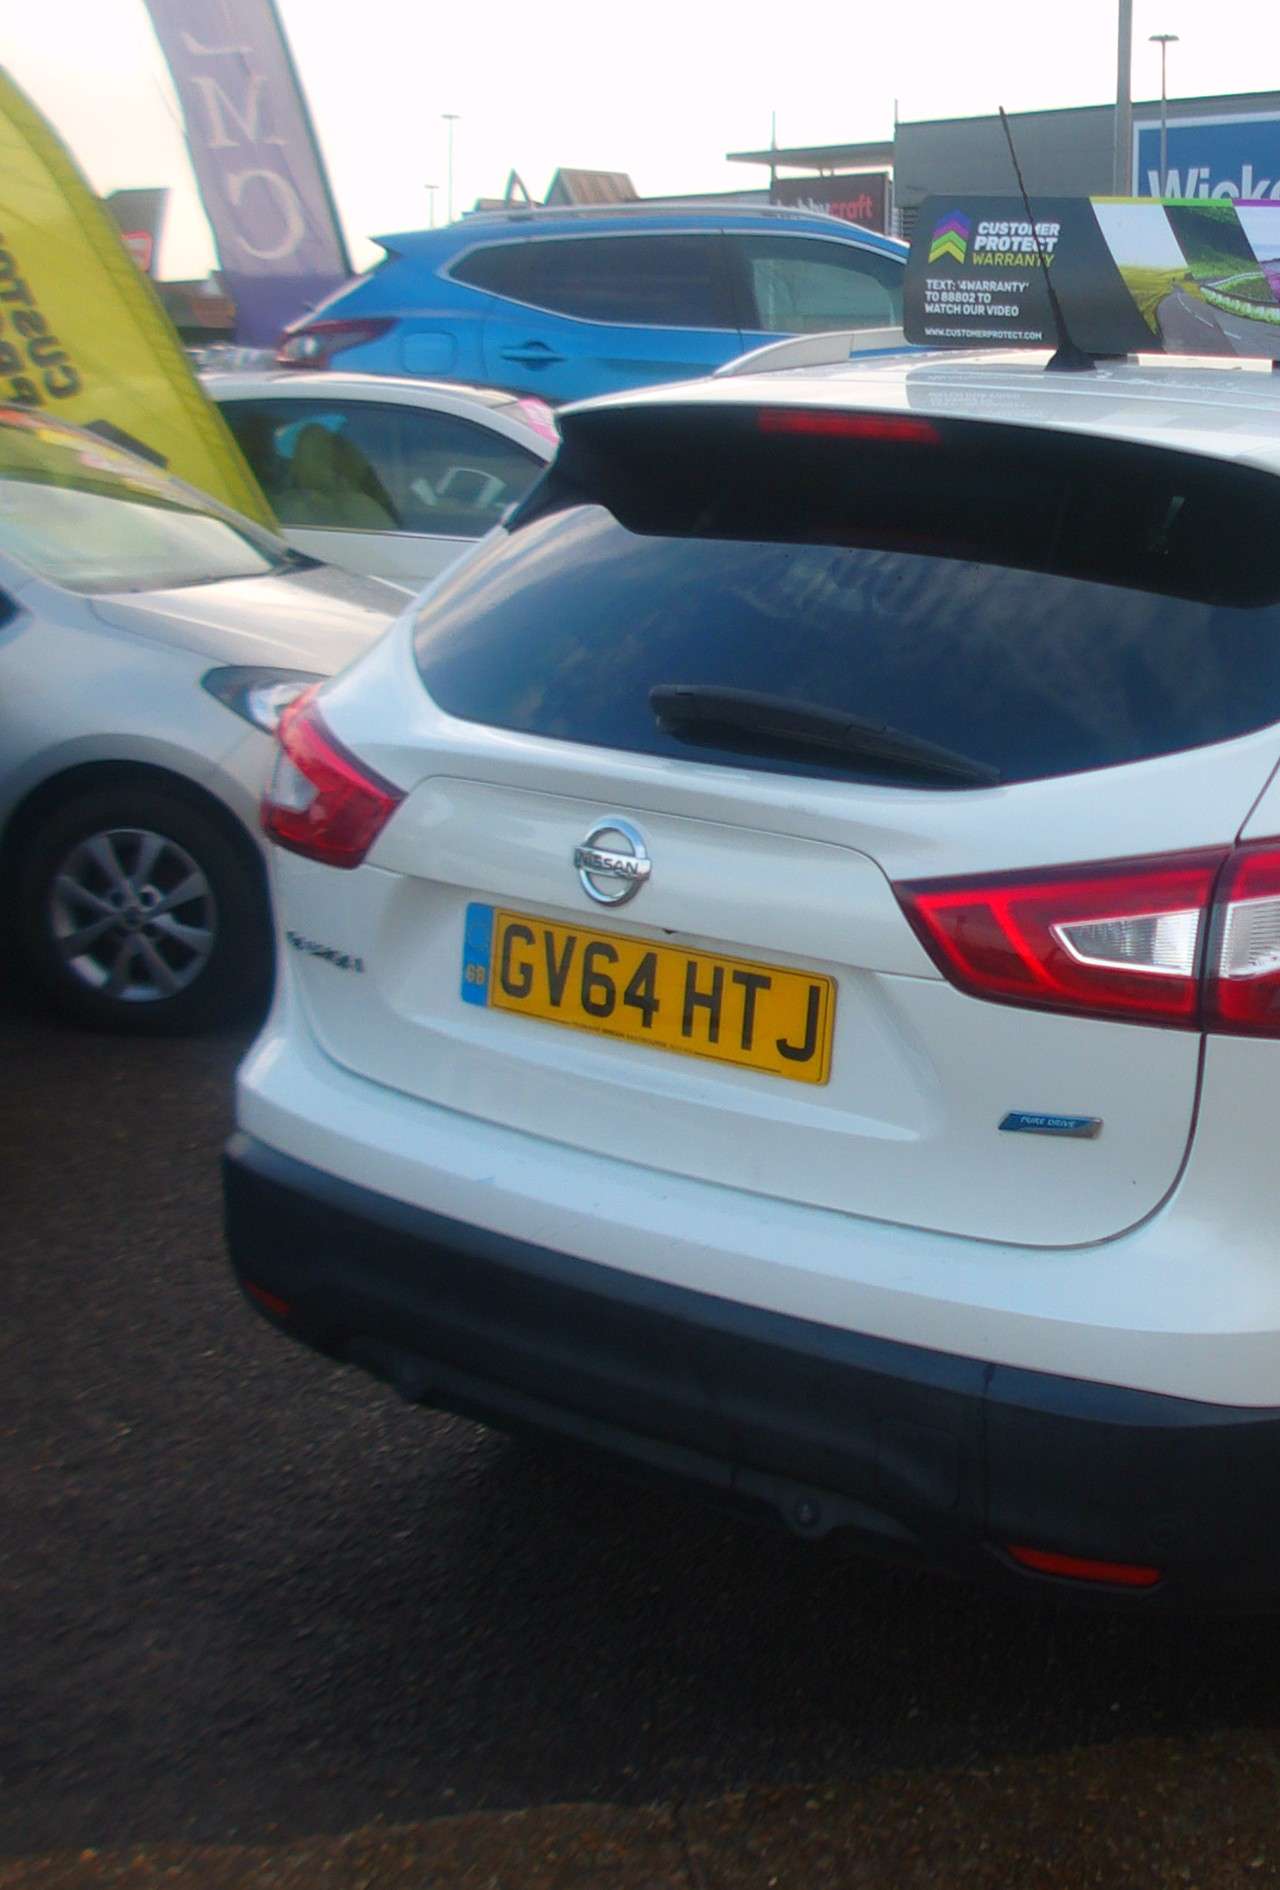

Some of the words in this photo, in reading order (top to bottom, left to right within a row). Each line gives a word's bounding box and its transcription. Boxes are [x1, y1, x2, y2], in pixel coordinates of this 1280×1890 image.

[977, 221, 1061, 236] CUSTOMER
[974, 235, 1059, 253] PROTECT
[972, 251, 1055, 268] WARRANTY
[925, 290, 940, 302] TO
[941, 291, 976, 304] 88802
[977, 292, 992, 304] TO
[924, 303, 961, 315] WATCH
[962, 304, 986, 316] OUR
[986, 305, 1020, 317] VIDEO
[924, 328, 1043, 340] WWW.CUSTOMERPROTECT.COM
[500, 922, 661, 1029] GV64
[681, 960, 822, 1062] HTJ
